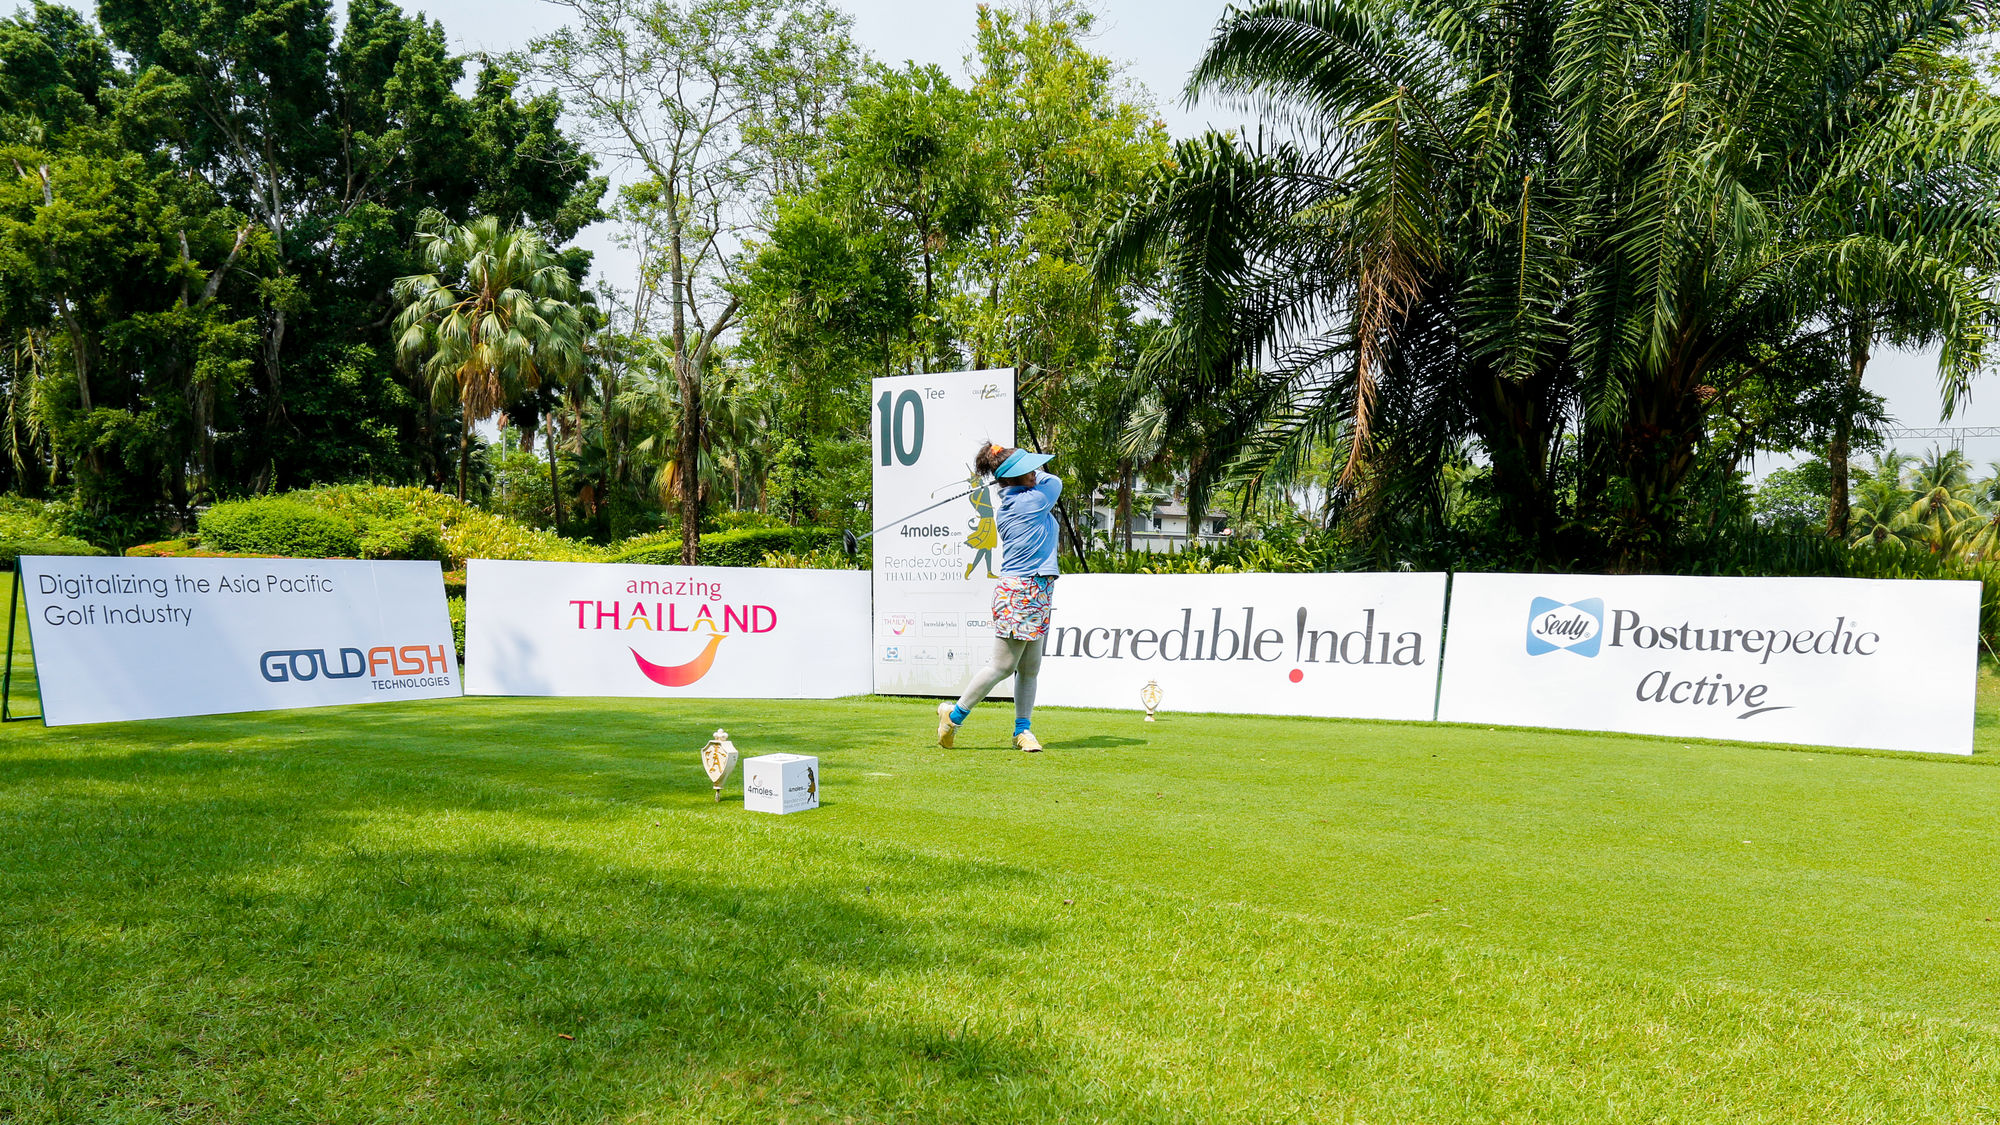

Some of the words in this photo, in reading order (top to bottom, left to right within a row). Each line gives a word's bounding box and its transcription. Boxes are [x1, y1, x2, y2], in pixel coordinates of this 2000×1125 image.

[924, 387, 945, 400] Tee
[877, 389, 924, 467] 10
[900, 524, 962, 538] 4moles.com
[931, 541, 962, 556] Golf
[884, 556, 963, 569] Rendezvous
[39, 574, 168, 599] Digitalizing
[175, 574, 210, 593] the
[217, 574, 260, 594] Asia
[267, 574, 334, 594] Pacific
[885, 571, 937, 582] THAILAND
[940, 571, 962, 581] 2019
[626, 577, 723, 602] amazing
[43, 604, 96, 626] Golf
[103, 605, 193, 628] Industry
[569, 600, 778, 634] THAILAND
[1536, 613, 1590, 641] Sealy
[1041, 606, 1284, 662] Incredible
[1608, 608, 1880, 665] Posturepedic
[259, 644, 449, 684] GOLDFISH
[371, 676, 450, 691] TECHNOLOGIES
